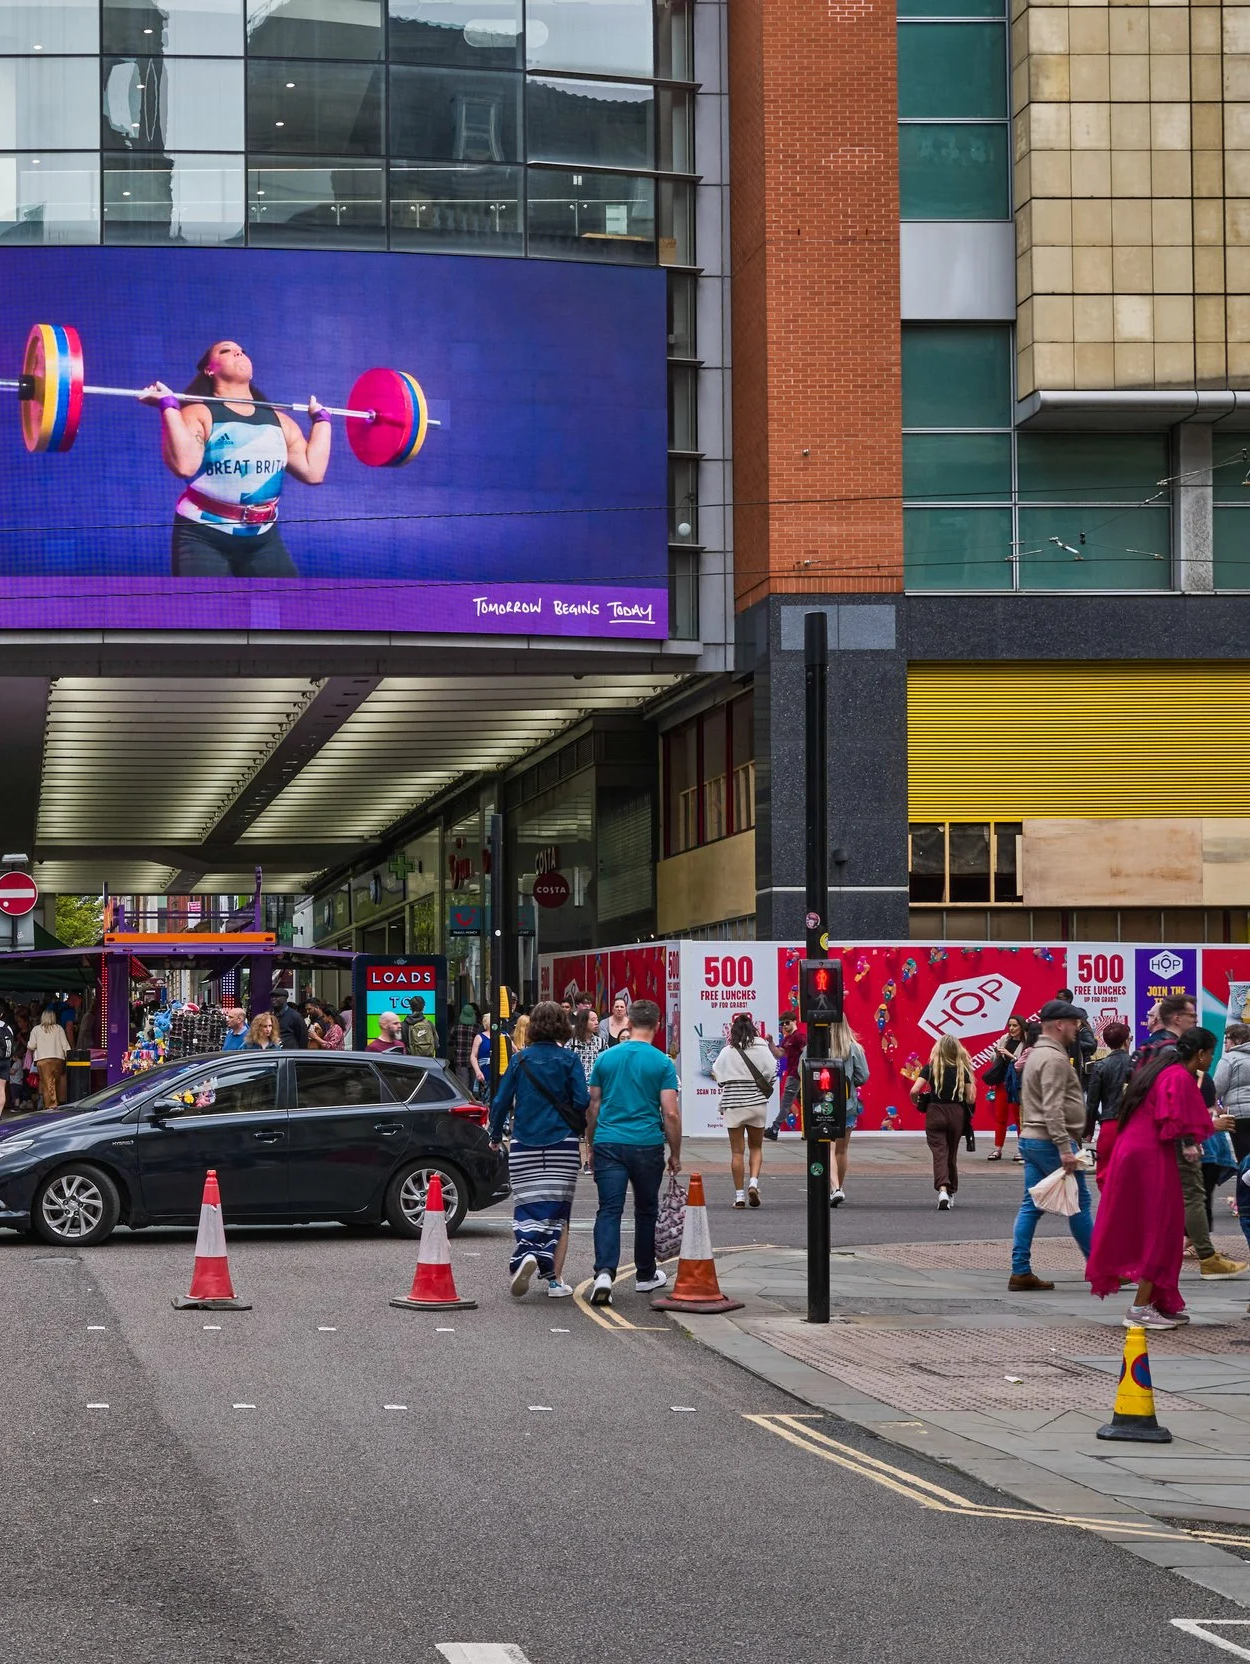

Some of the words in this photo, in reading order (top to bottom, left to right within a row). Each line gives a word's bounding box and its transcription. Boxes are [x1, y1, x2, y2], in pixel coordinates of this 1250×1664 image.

[205, 459, 250, 476] GREAT
[472, 596, 542, 617] TOMORROW
[553, 600, 600, 616] BEGINS
[606, 601, 653, 621] TODAY
[536, 886, 567, 894] COSTA
[704, 955, 754, 988] 500
[1078, 953, 1124, 984] 500
[372, 971, 431, 984] LOADS
[700, 990, 719, 1001] FREE
[721, 989, 756, 1001] LUNCHES
[1074, 986, 1092, 996] FREE
[1093, 985, 1127, 996] LUNCHES
[1146, 985, 1168, 997] JOIN
[729, 1001, 748, 1009] GRABS!
